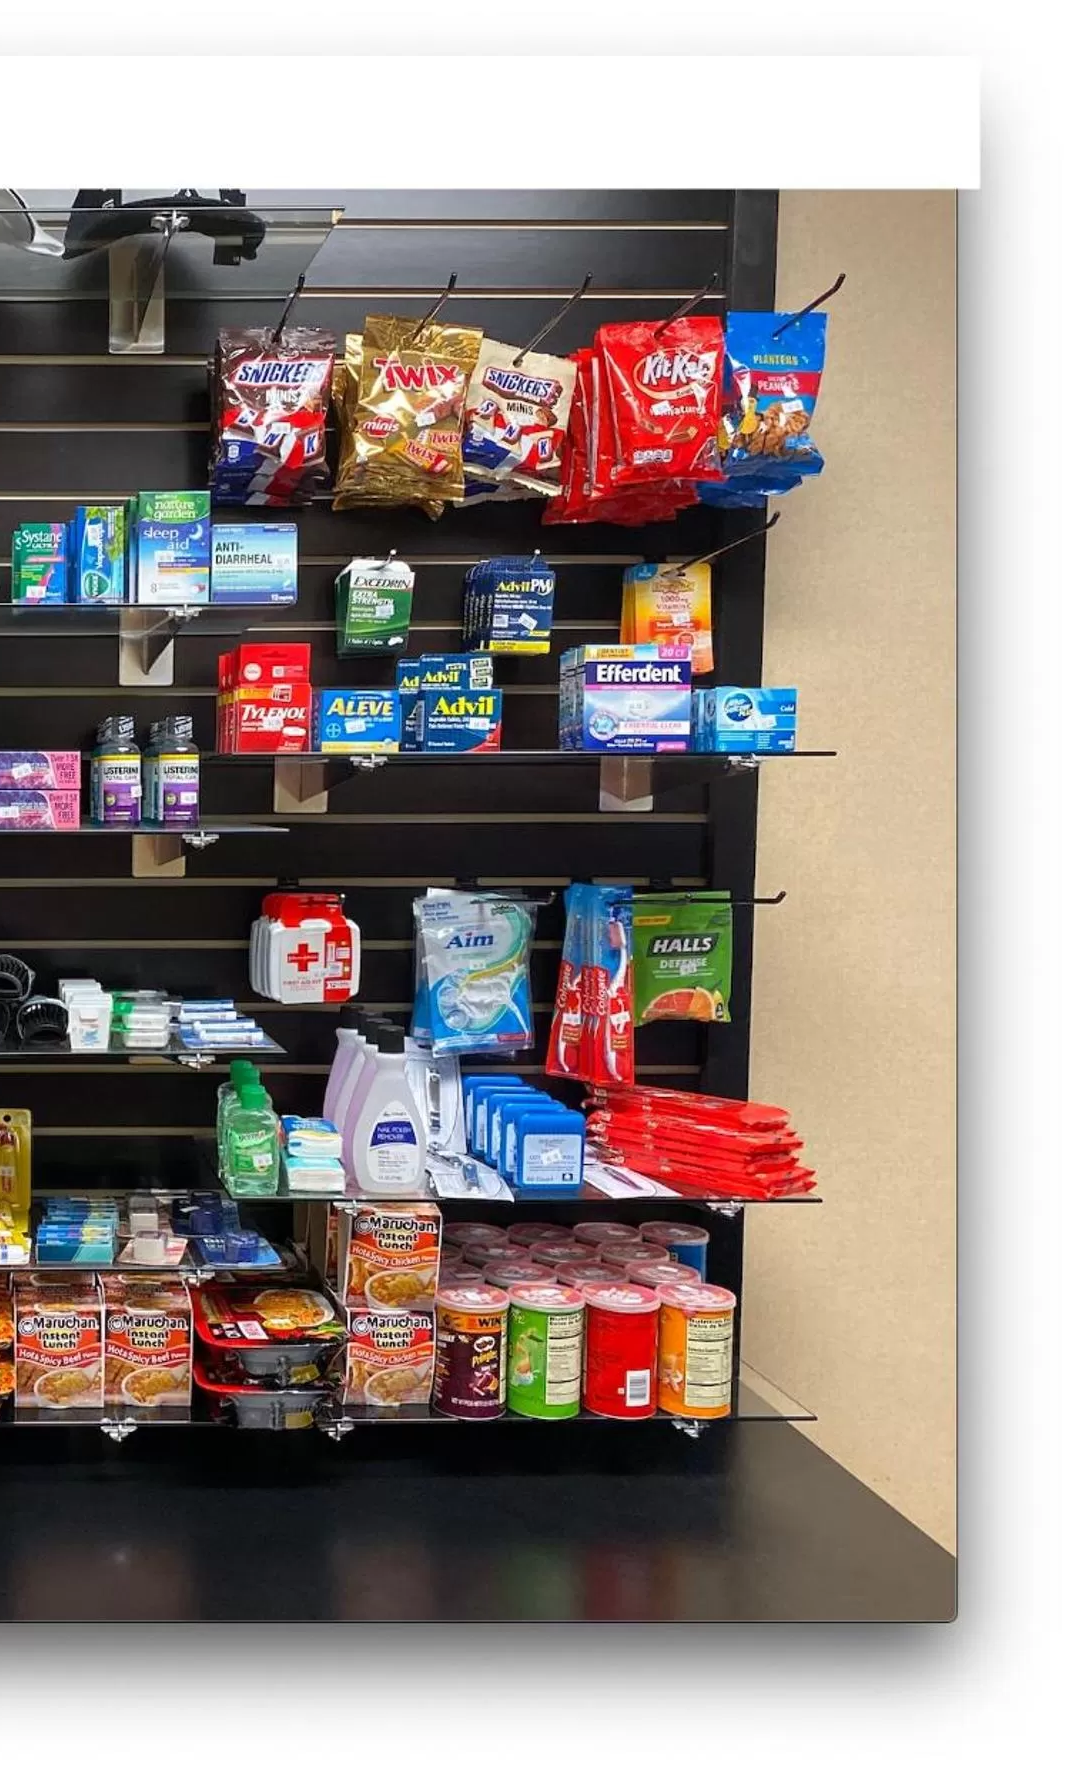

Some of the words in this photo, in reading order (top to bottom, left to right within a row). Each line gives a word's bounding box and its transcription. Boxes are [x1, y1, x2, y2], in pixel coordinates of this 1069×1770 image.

[487, 367, 552, 398] SNICKERS
[362, 418, 400, 433] minis
[155, 499, 195, 510] nature
[155, 508, 196, 520] garden
[144, 527, 179, 540] sleep
[167, 538, 190, 550] aid
[215, 541, 244, 553] ANTI-
[215, 554, 273, 565] DIARRHEAL
[422, 671, 460, 683] Advil
[596, 663, 683, 683] Efferdent
[327, 697, 394, 716] ALEVE
[431, 696, 494, 716] Advil
[241, 704, 307, 721] TYLENOL
[444, 931, 495, 950] Aim
[652, 936, 713, 954] HALLS
[558, 964, 572, 1009] Colgate
[596, 970, 607, 1015] Colgate
[370, 1216, 435, 1232] Maruchan
[373, 1230, 418, 1242] Instant
[378, 1240, 413, 1250] Lunch
[33, 1315, 98, 1329] Maruchan
[123, 1315, 186, 1329] Maruchan
[366, 1316, 430, 1328] Maruchan
[37, 1330, 81, 1341] Instant
[126, 1329, 170, 1340] Instant
[370, 1330, 414, 1340] Instant
[42, 1339, 77, 1349] Lunch
[131, 1338, 165, 1348] Lunch
[376, 1339, 410, 1348] Lunch
